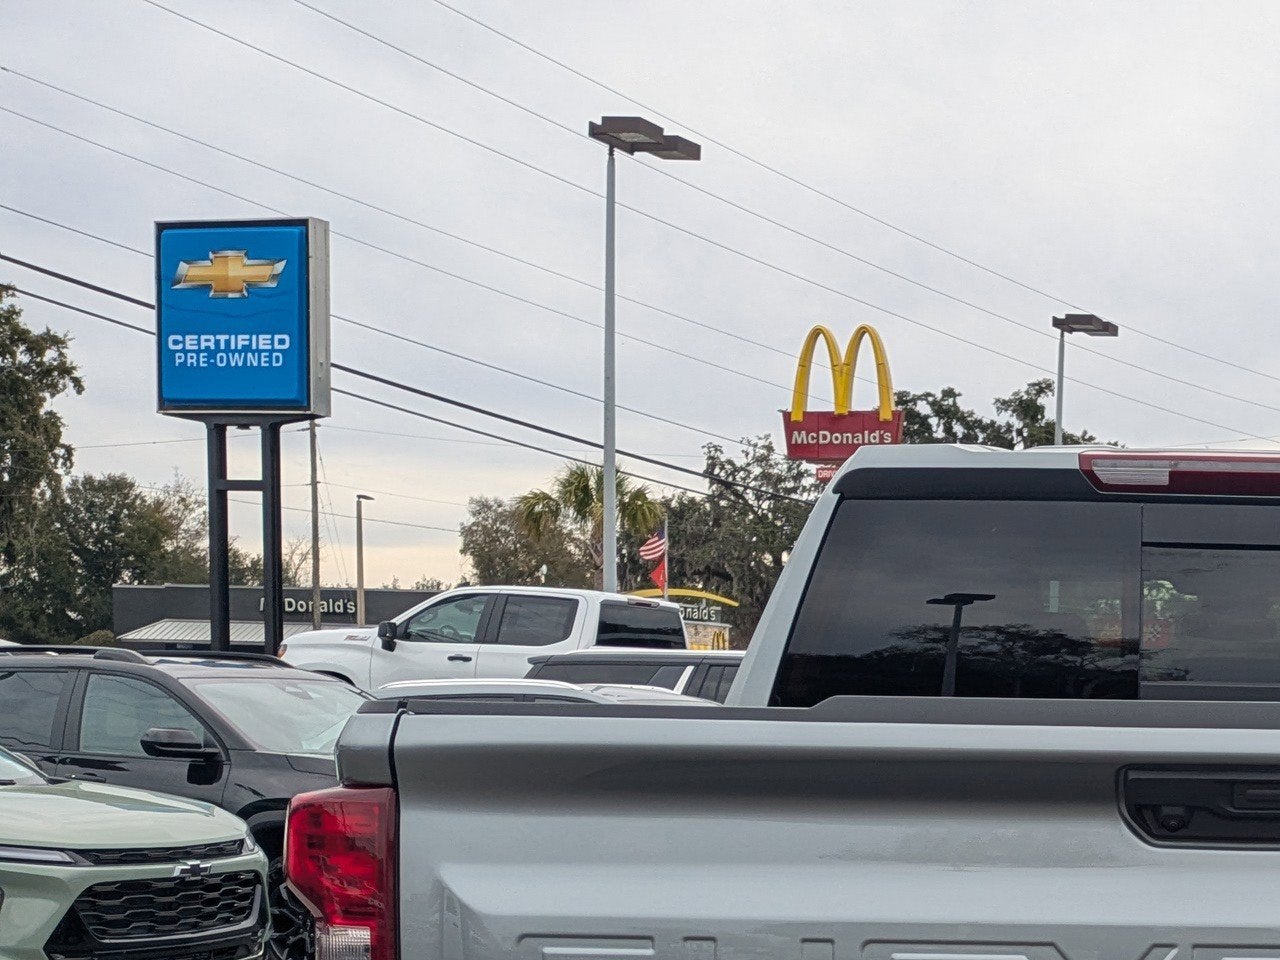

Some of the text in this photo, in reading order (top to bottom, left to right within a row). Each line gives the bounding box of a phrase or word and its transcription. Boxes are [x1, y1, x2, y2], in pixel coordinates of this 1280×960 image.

[167, 333, 291, 351] CERTIFIED
[174, 351, 284, 367] PRE-OWNED
[790, 429, 893, 445] McDonald's
[259, 597, 357, 613] Doald's
